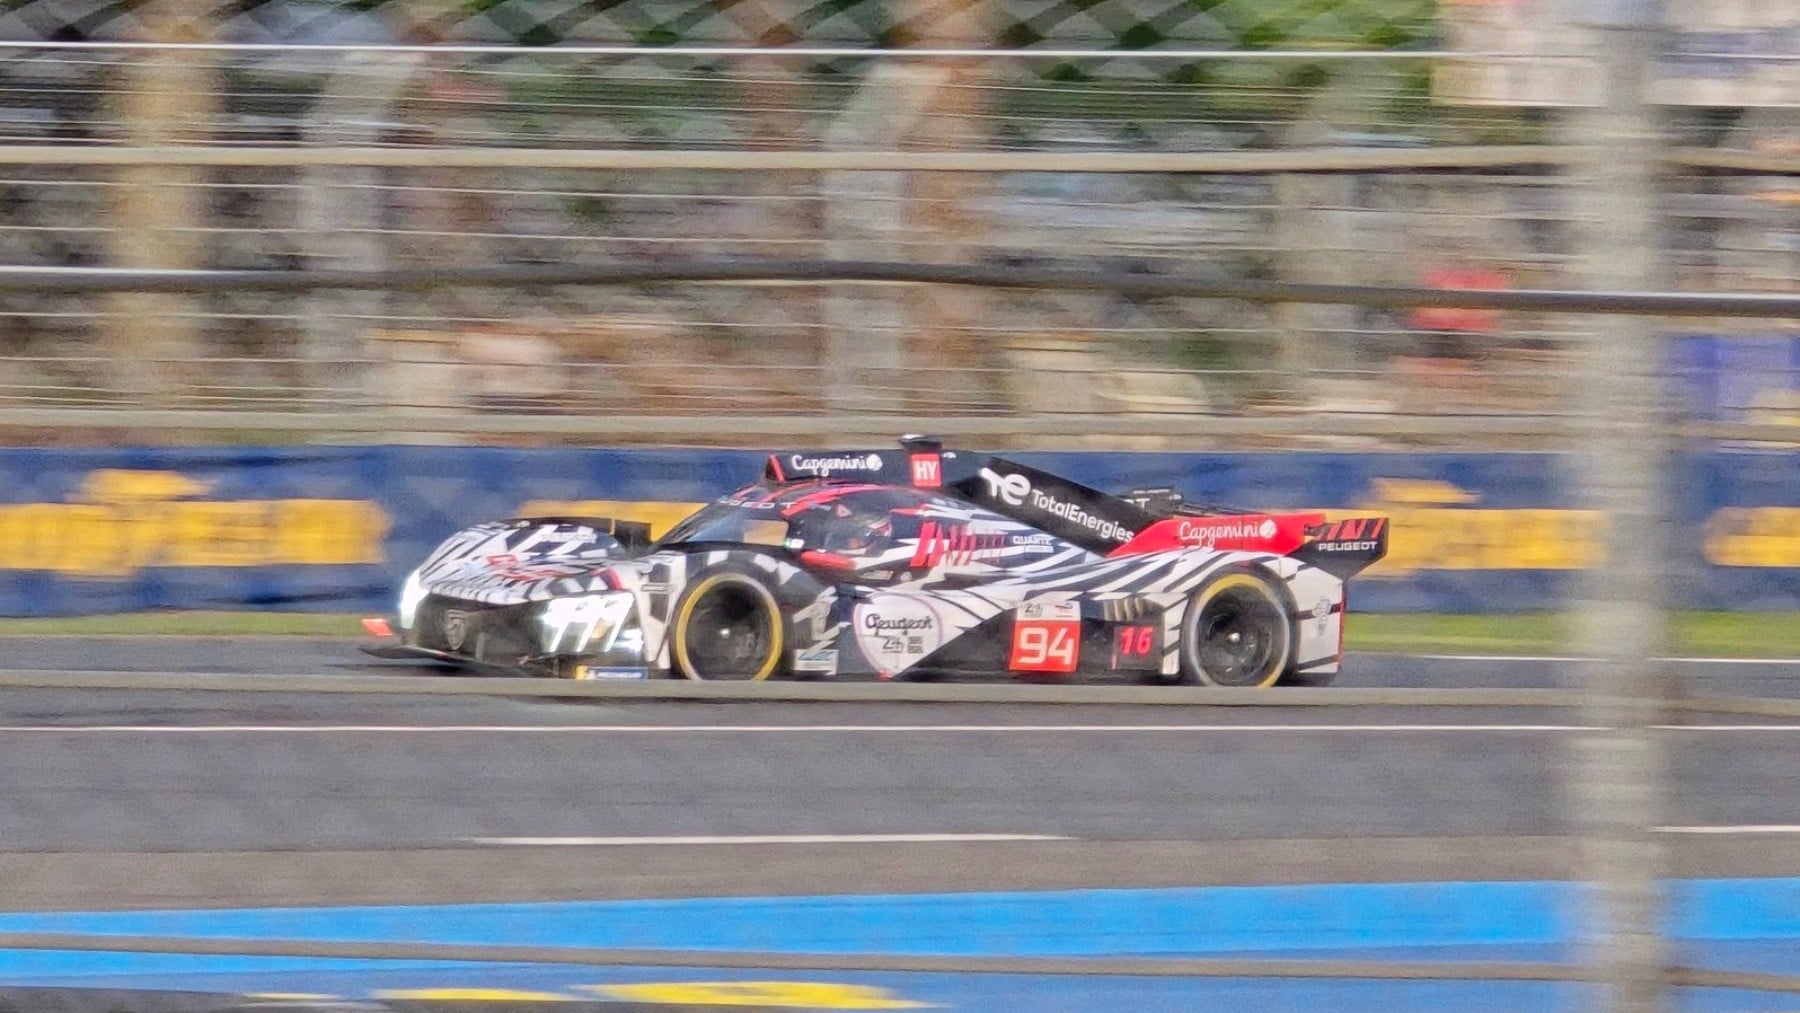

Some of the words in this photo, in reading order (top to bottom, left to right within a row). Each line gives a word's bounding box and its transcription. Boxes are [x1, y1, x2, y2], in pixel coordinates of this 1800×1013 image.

[791, 454, 865, 477] Capgemini
[915, 460, 937, 480] HY
[1032, 489, 1135, 542] TotalEnergies
[1179, 521, 1258, 547] Capgemini
[1318, 541, 1378, 551] PEUGEOT
[1018, 627, 1075, 665] 94
[1120, 626, 1154, 655] 16
